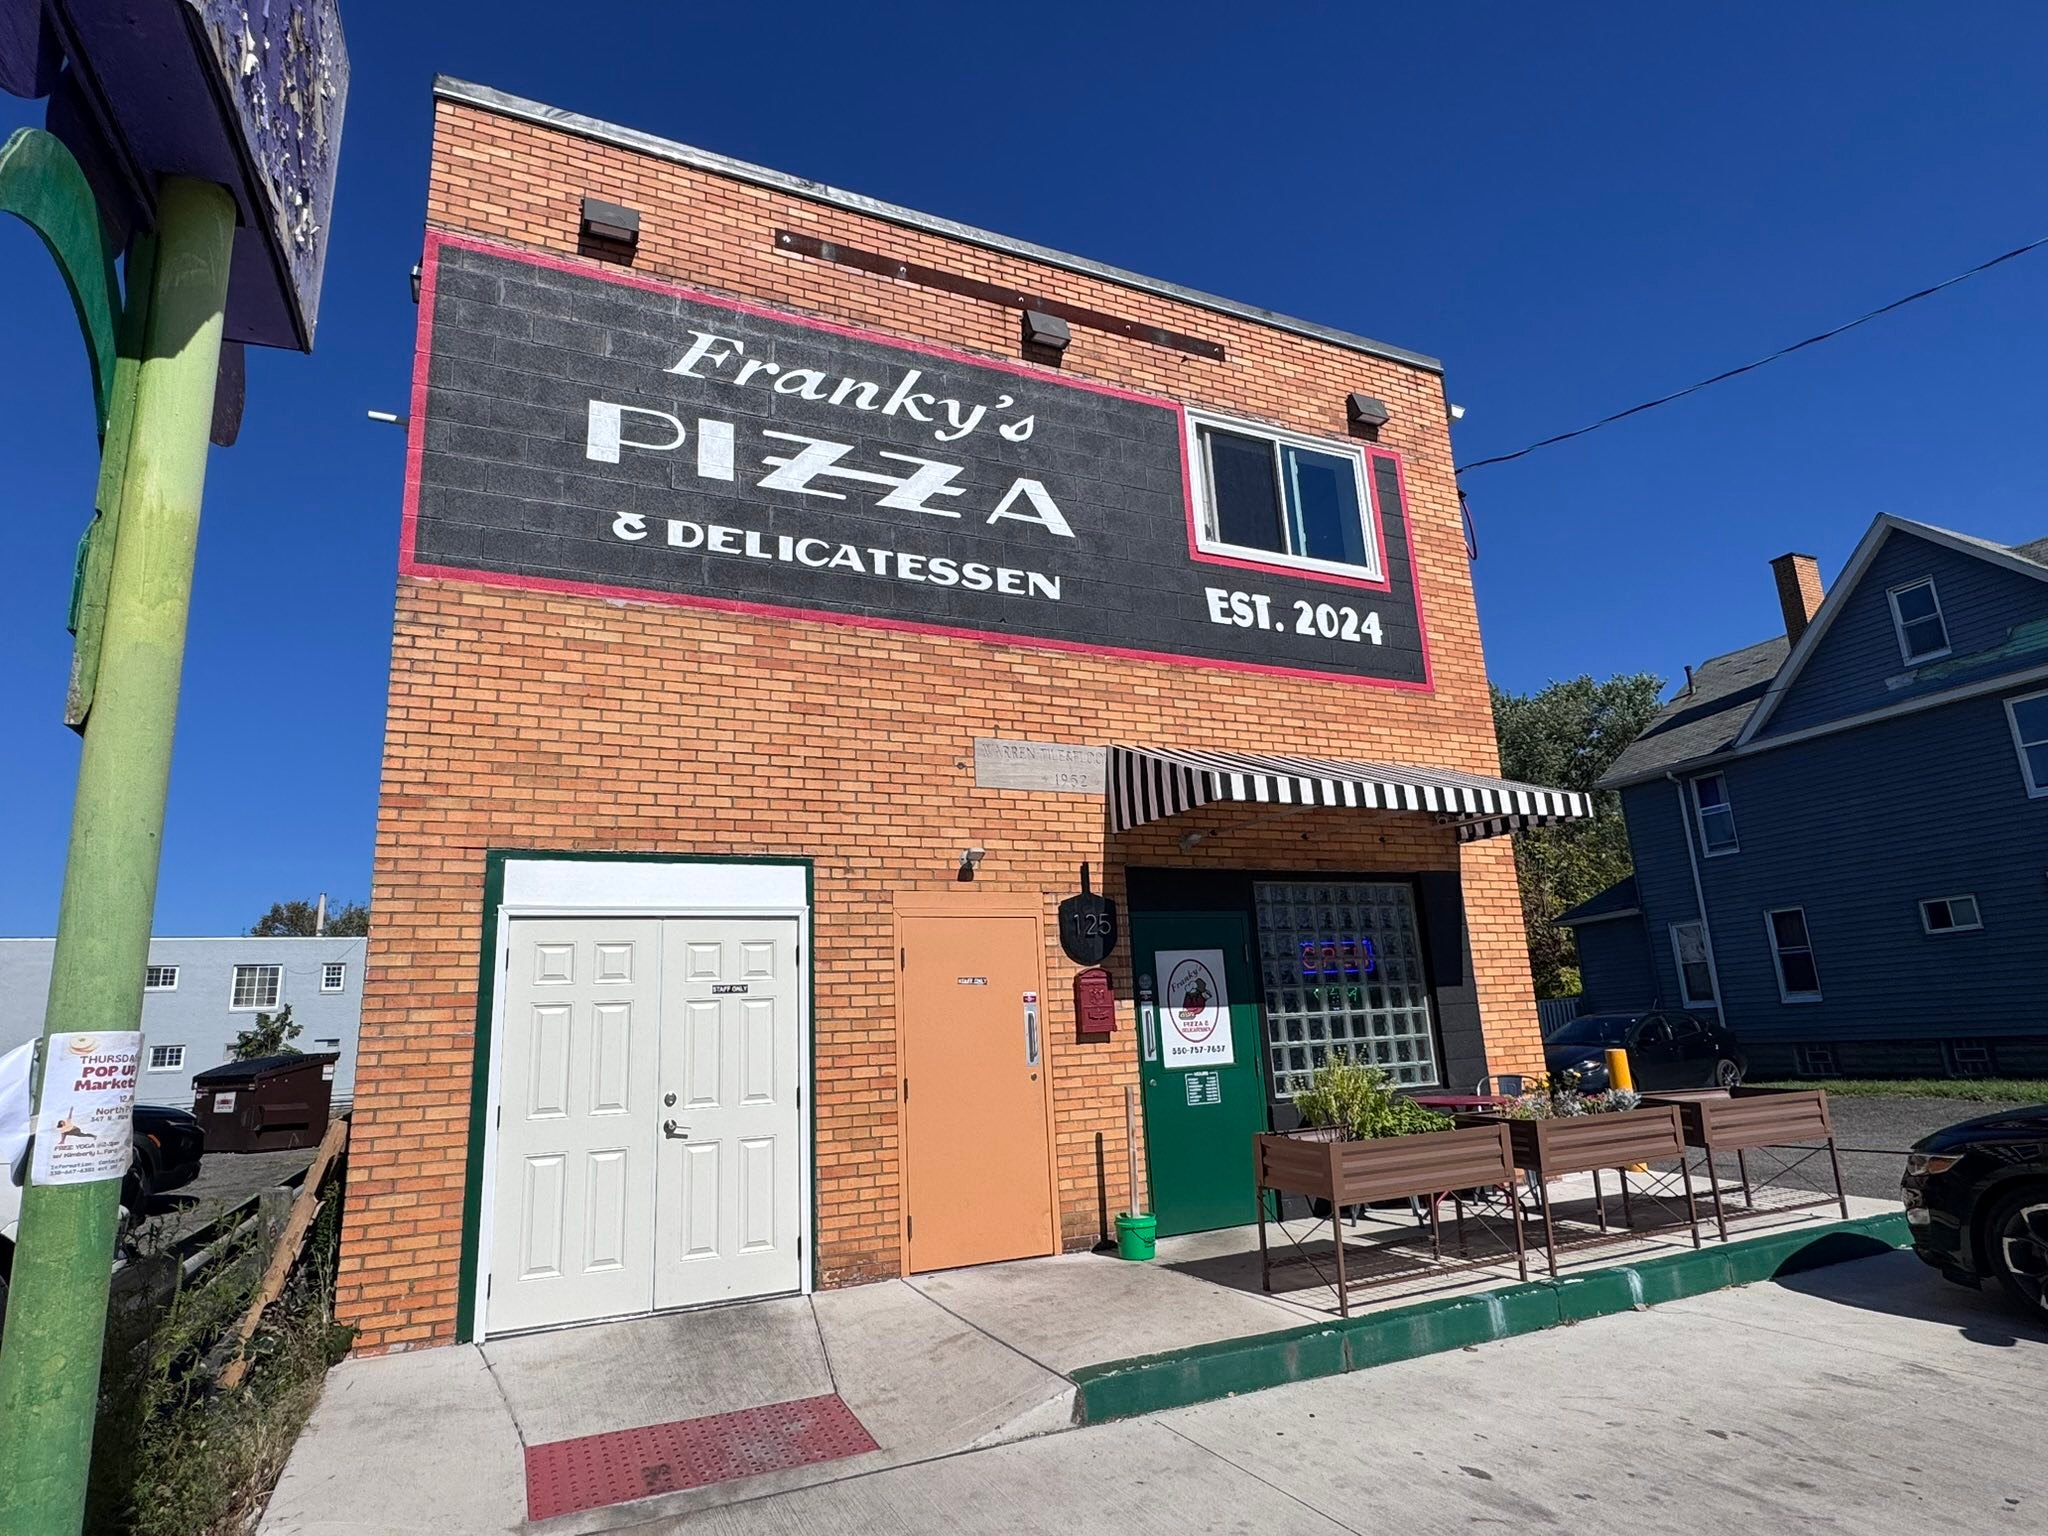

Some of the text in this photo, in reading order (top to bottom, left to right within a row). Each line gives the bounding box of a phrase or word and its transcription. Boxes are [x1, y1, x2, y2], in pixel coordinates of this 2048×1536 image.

[663, 330, 1035, 443] Franky's
[586, 399, 1075, 538] PIZZA
[667, 519, 1060, 600] DELICATESSEN
[1204, 587, 1383, 645] EST. 2024
[981, 743, 1036, 759] WARREN
[1055, 774, 1088, 787] 1952
[1073, 913, 1112, 935] 125
[80, 1054, 137, 1064] THURSDA
[82, 1066, 119, 1078] POP
[96, 1106, 124, 1115] North
